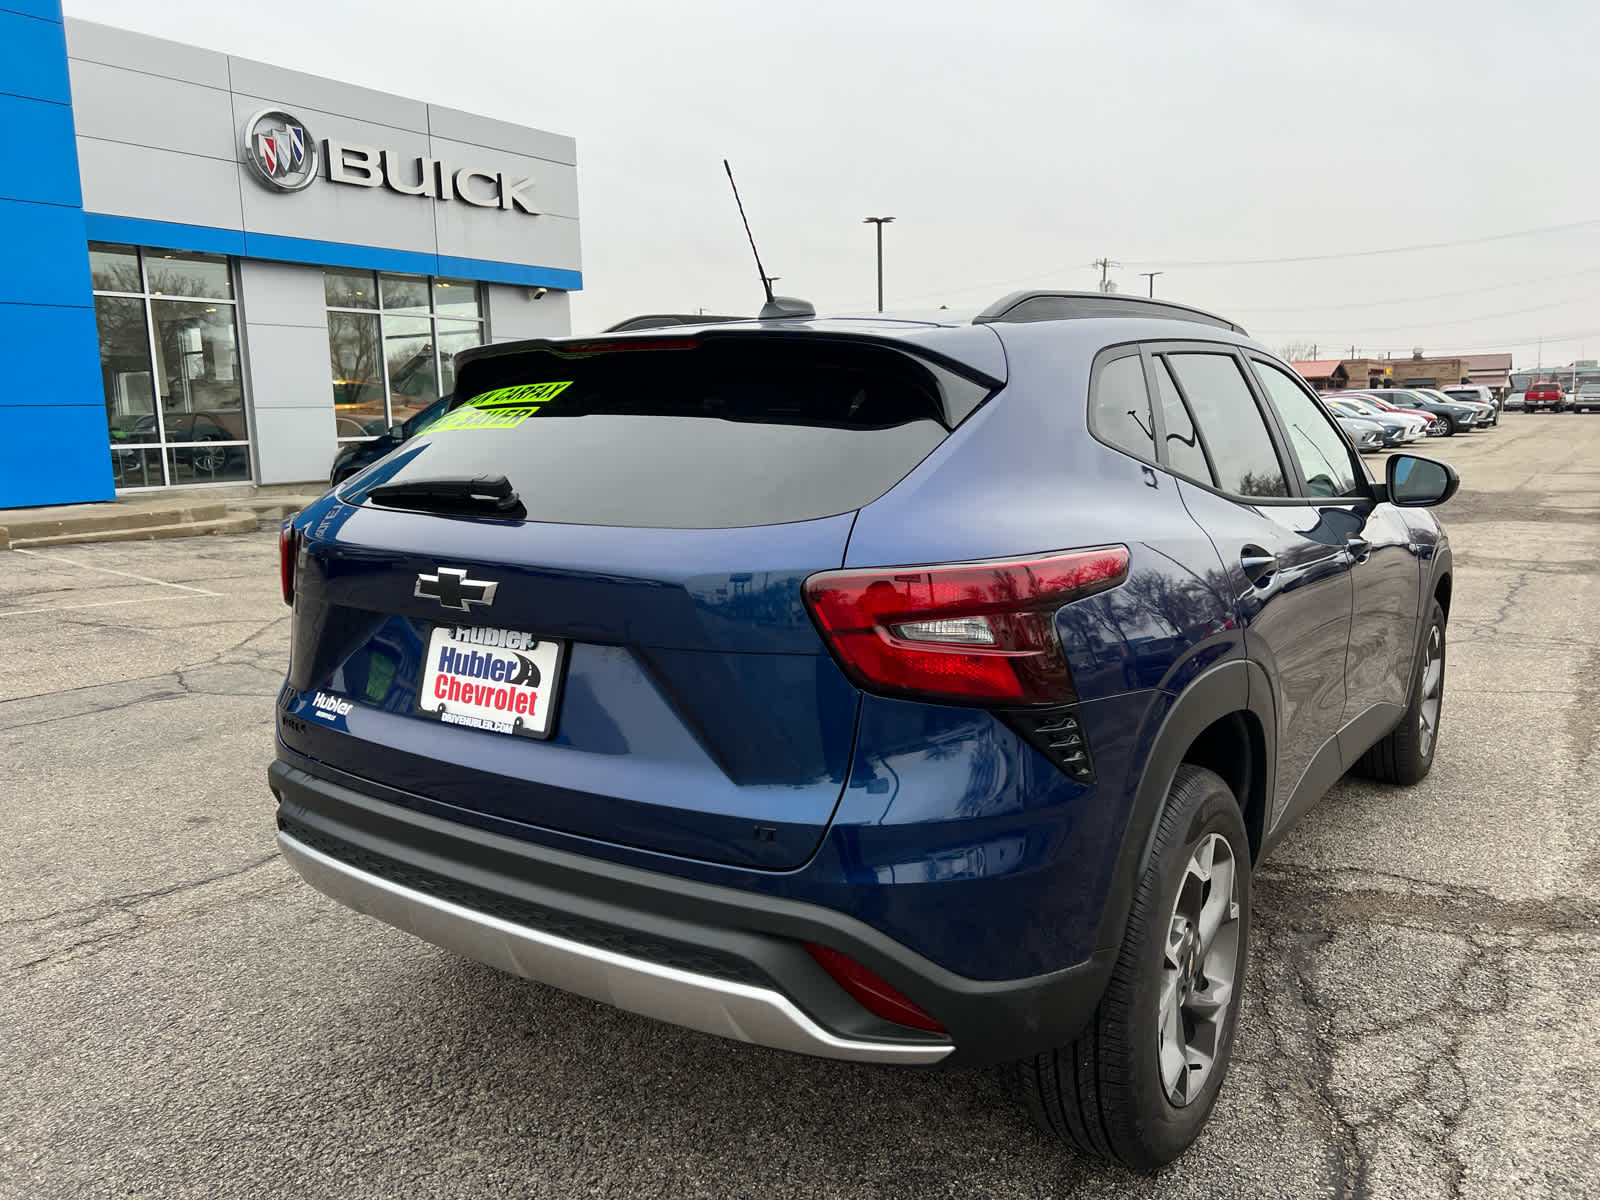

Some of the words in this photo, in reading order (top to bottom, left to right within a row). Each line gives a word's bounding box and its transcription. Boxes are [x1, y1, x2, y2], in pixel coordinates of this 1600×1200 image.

[322, 138, 542, 215] BUICK
[438, 645, 517, 682] Hubler
[311, 691, 354, 716] Hubler
[434, 673, 538, 717] Chevrolet
